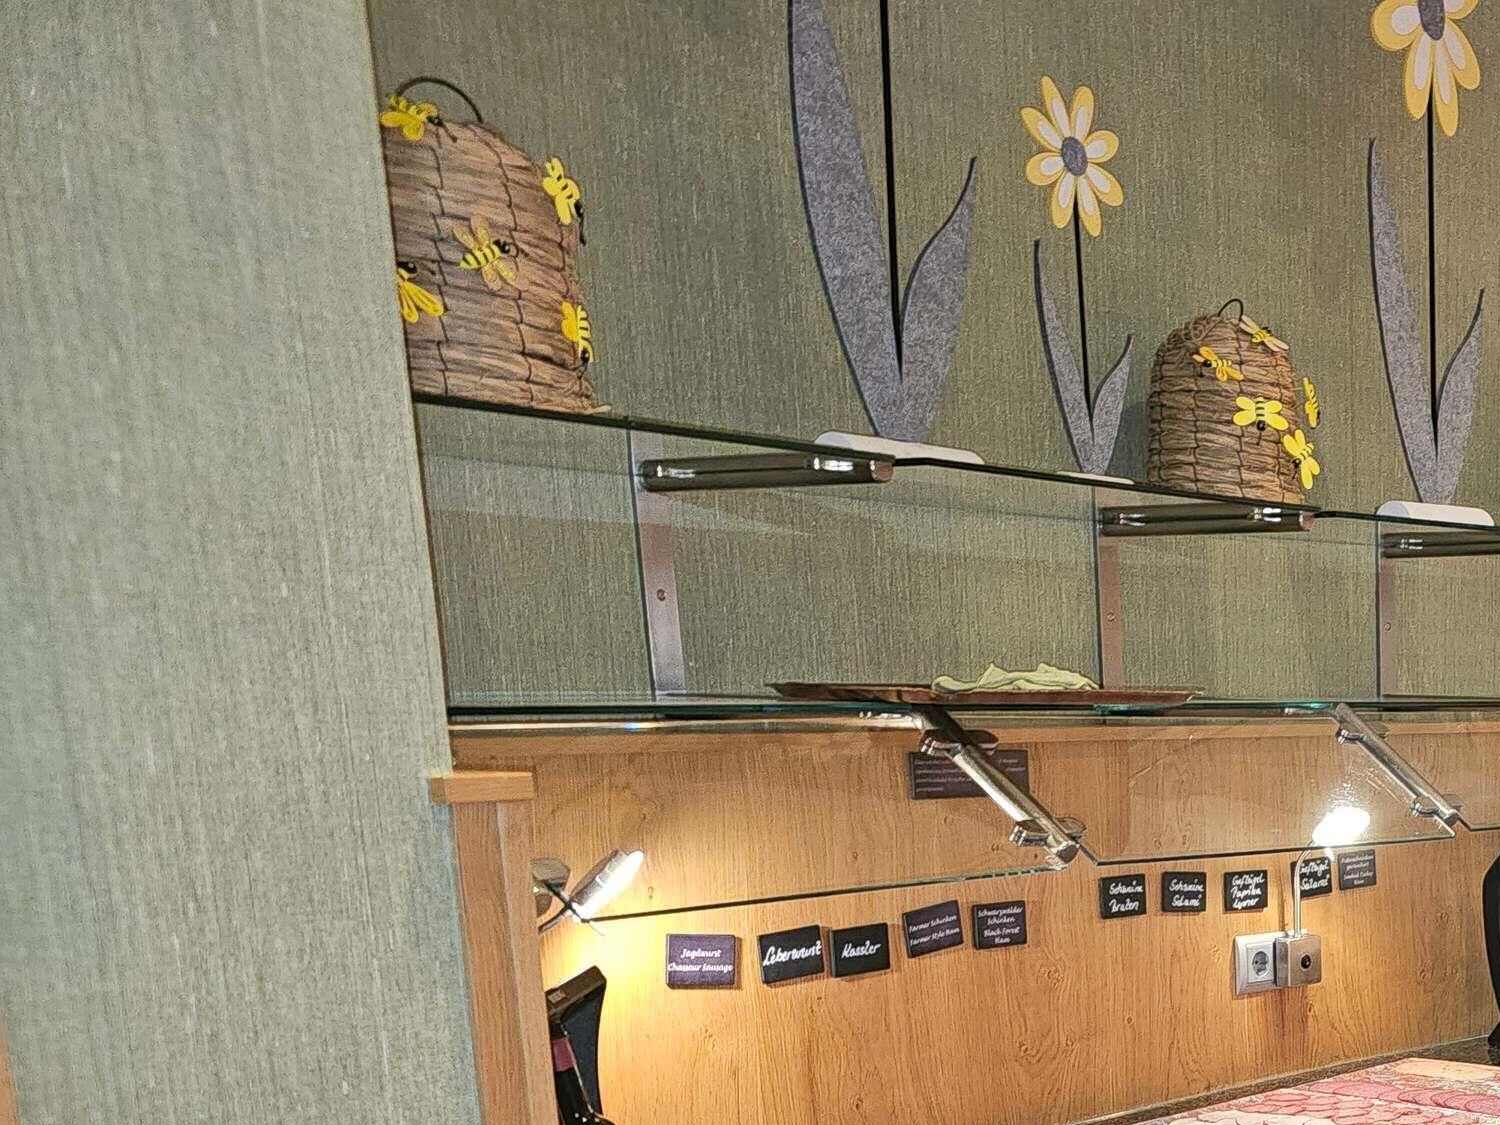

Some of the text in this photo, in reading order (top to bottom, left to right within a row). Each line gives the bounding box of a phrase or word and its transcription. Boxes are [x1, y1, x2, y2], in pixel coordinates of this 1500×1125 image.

[680, 948, 722, 959] Jagdwurst
[762, 940, 823, 966] Leberwurst
[841, 940, 882, 959] Kassler
